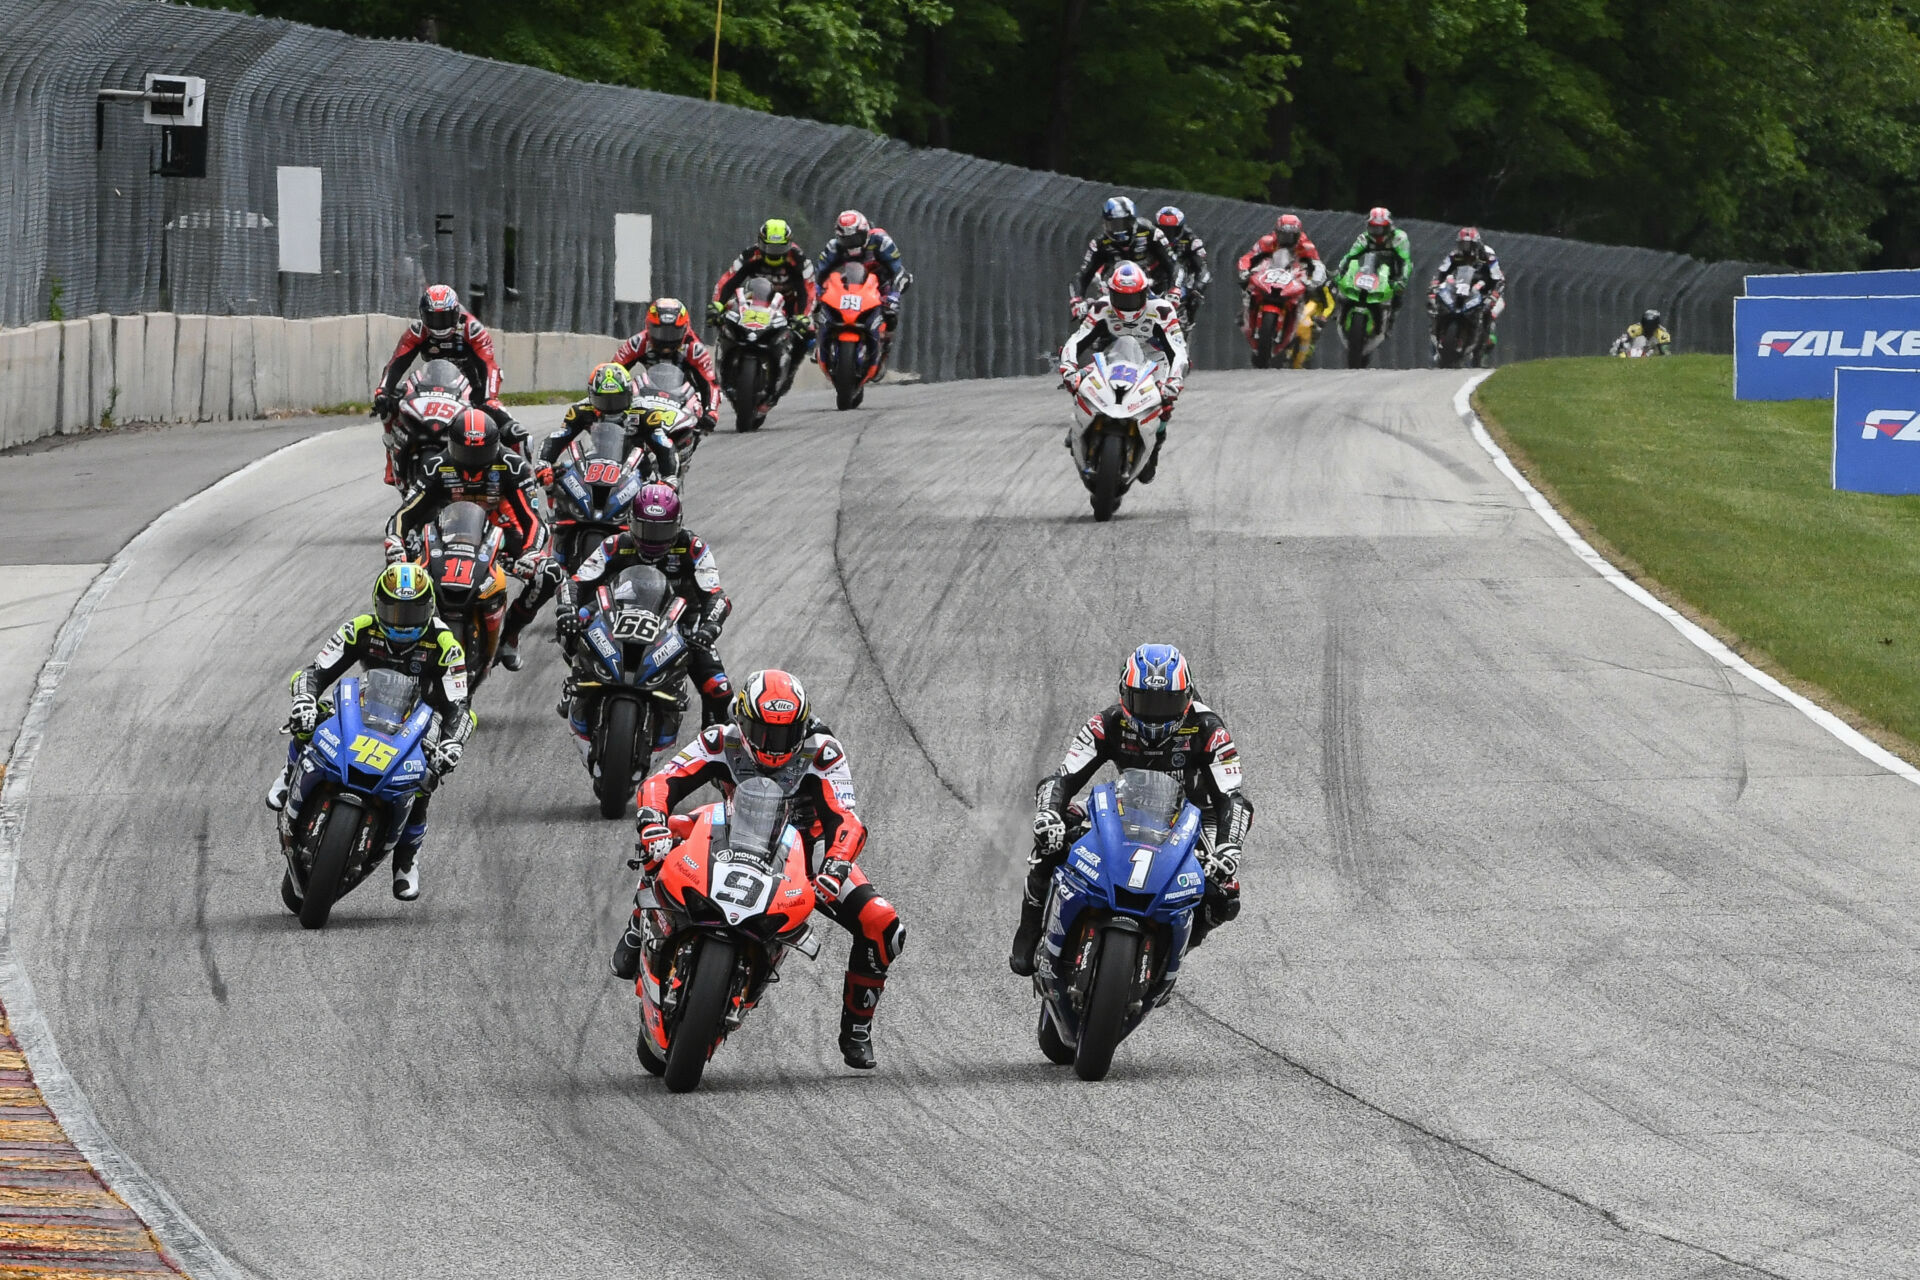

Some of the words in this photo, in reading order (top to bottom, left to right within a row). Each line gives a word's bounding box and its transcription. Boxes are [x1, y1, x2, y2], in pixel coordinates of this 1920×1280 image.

[423, 402, 455, 418] 85
[584, 463, 620, 484] 80
[441, 557, 475, 588] 11
[396, 588, 416, 596] Arai
[612, 614, 660, 642] 66
[1144, 676, 1167, 685] Arai
[768, 700, 793, 711] X-lite
[318, 738, 338, 759] YAMAHA
[349, 736, 399, 772] 45
[734, 851, 760, 862] MOUNT
[675, 861, 700, 885] Medallia
[1075, 859, 1100, 881] YAMAHA
[1127, 848, 1155, 890] 1
